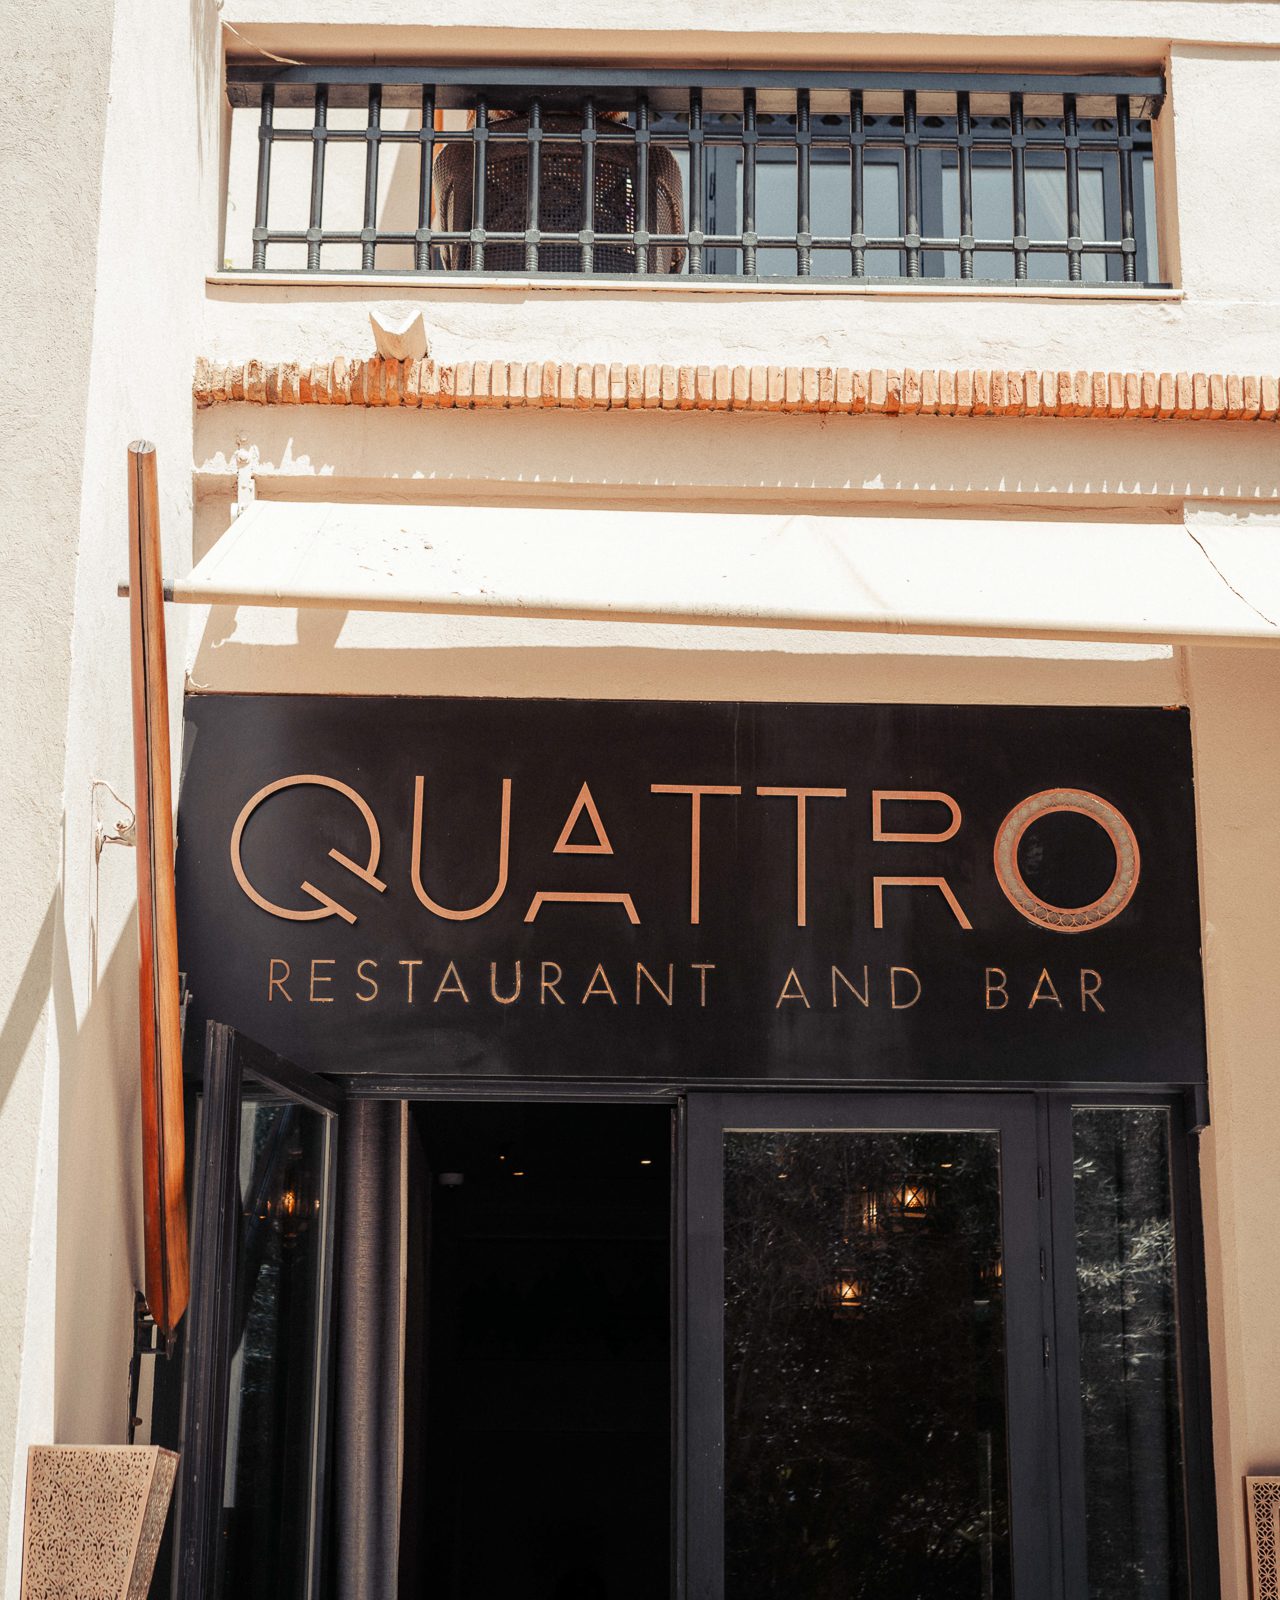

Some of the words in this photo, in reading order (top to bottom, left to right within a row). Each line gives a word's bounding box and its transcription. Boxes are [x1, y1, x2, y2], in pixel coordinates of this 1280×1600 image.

[229, 773, 1141, 933] QUATTRO
[267, 958, 717, 1008] RESTAURANT
[775, 965, 923, 1011] AND
[984, 967, 1106, 1013] BAR
